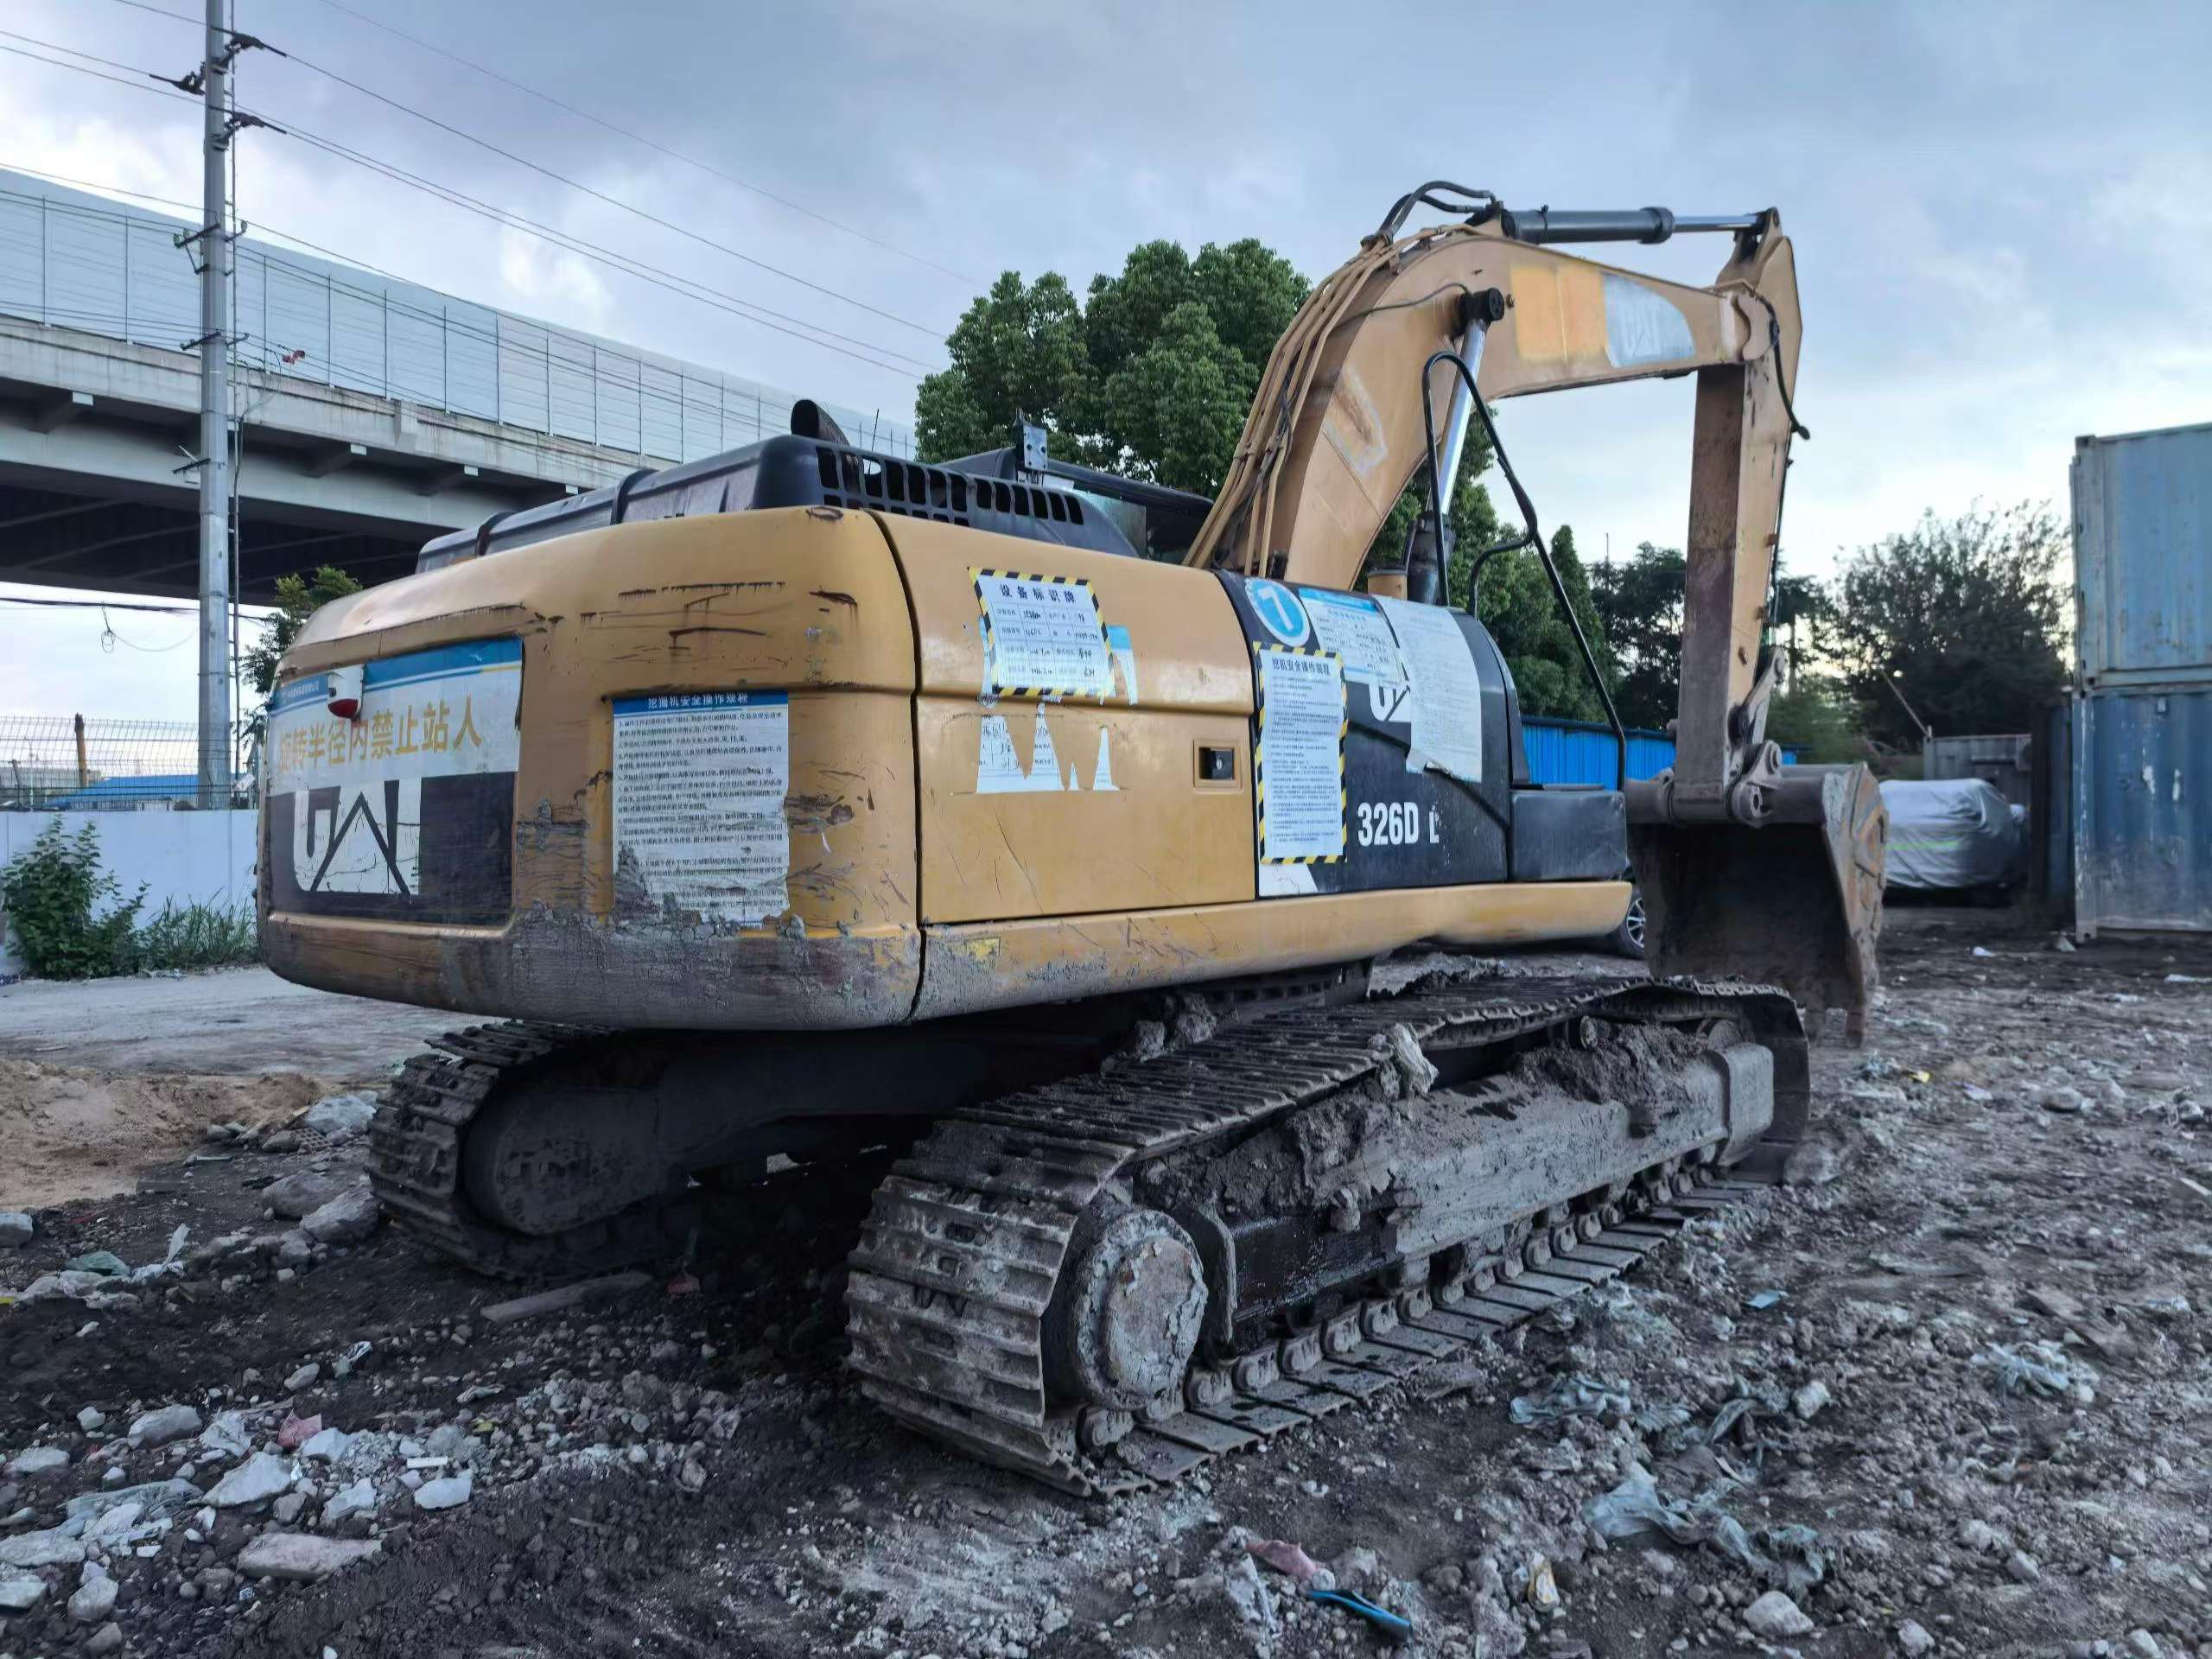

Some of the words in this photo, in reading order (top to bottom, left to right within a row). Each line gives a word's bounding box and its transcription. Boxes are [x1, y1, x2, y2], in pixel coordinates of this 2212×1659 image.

[1000, 583, 1077, 605] 设备标识牌
[1357, 801, 1419, 847] 326D
